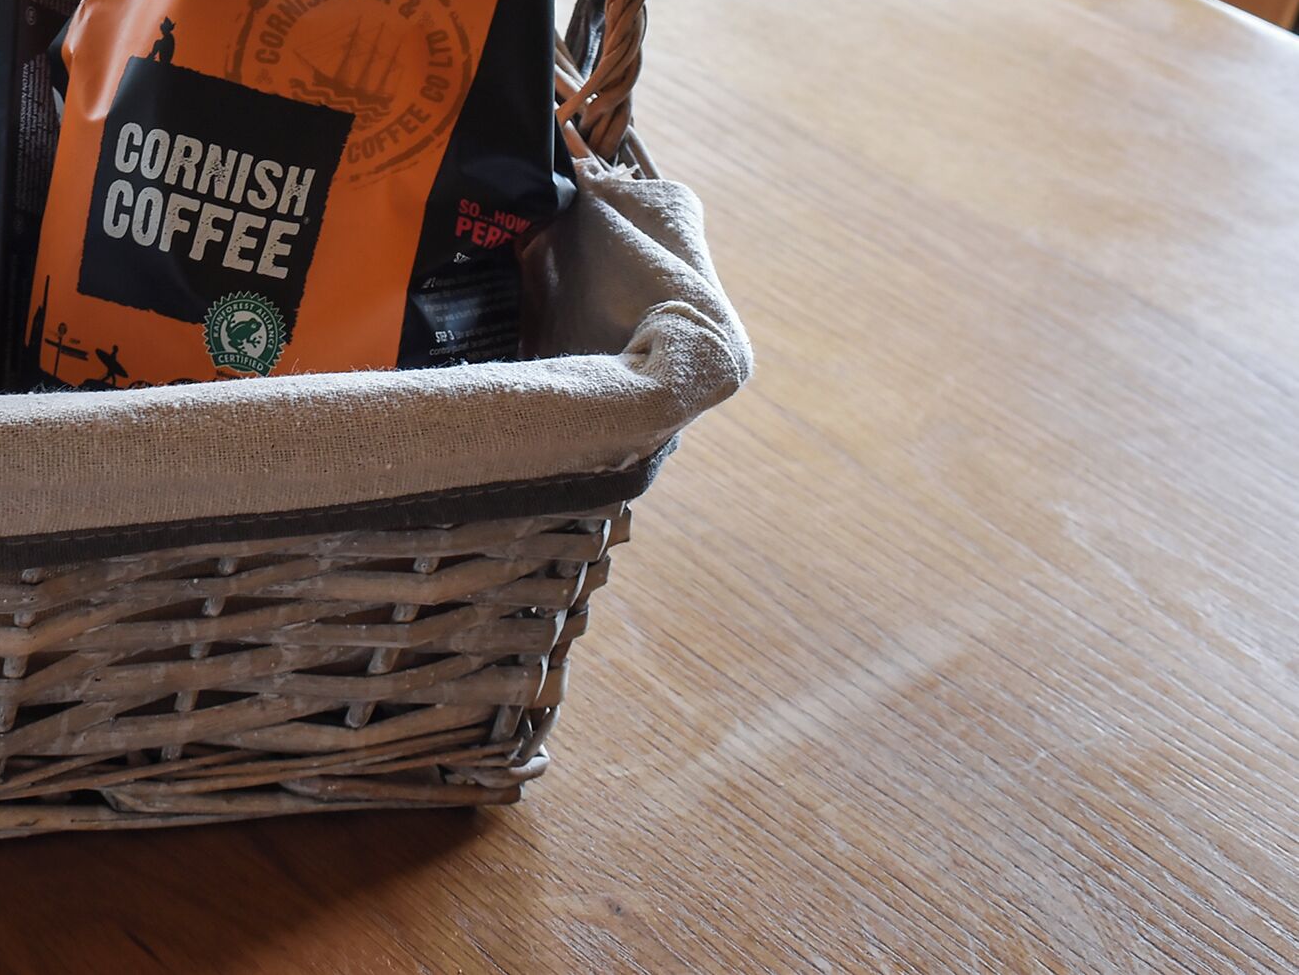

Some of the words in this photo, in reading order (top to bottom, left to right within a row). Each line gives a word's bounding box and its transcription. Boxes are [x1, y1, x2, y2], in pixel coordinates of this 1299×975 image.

[425, 28, 455, 70] LTD
[22, 63, 30, 92] NOTEN
[418, 71, 452, 105] CO
[345, 101, 432, 165] COFFEE
[114, 121, 316, 217] CORNISH
[102, 178, 301, 280] COFFEE
[213, 302, 255, 338] RAINFOREST
[255, 307, 275, 349] ALLIANCE
[217, 353, 264, 371] CERTIFIED
